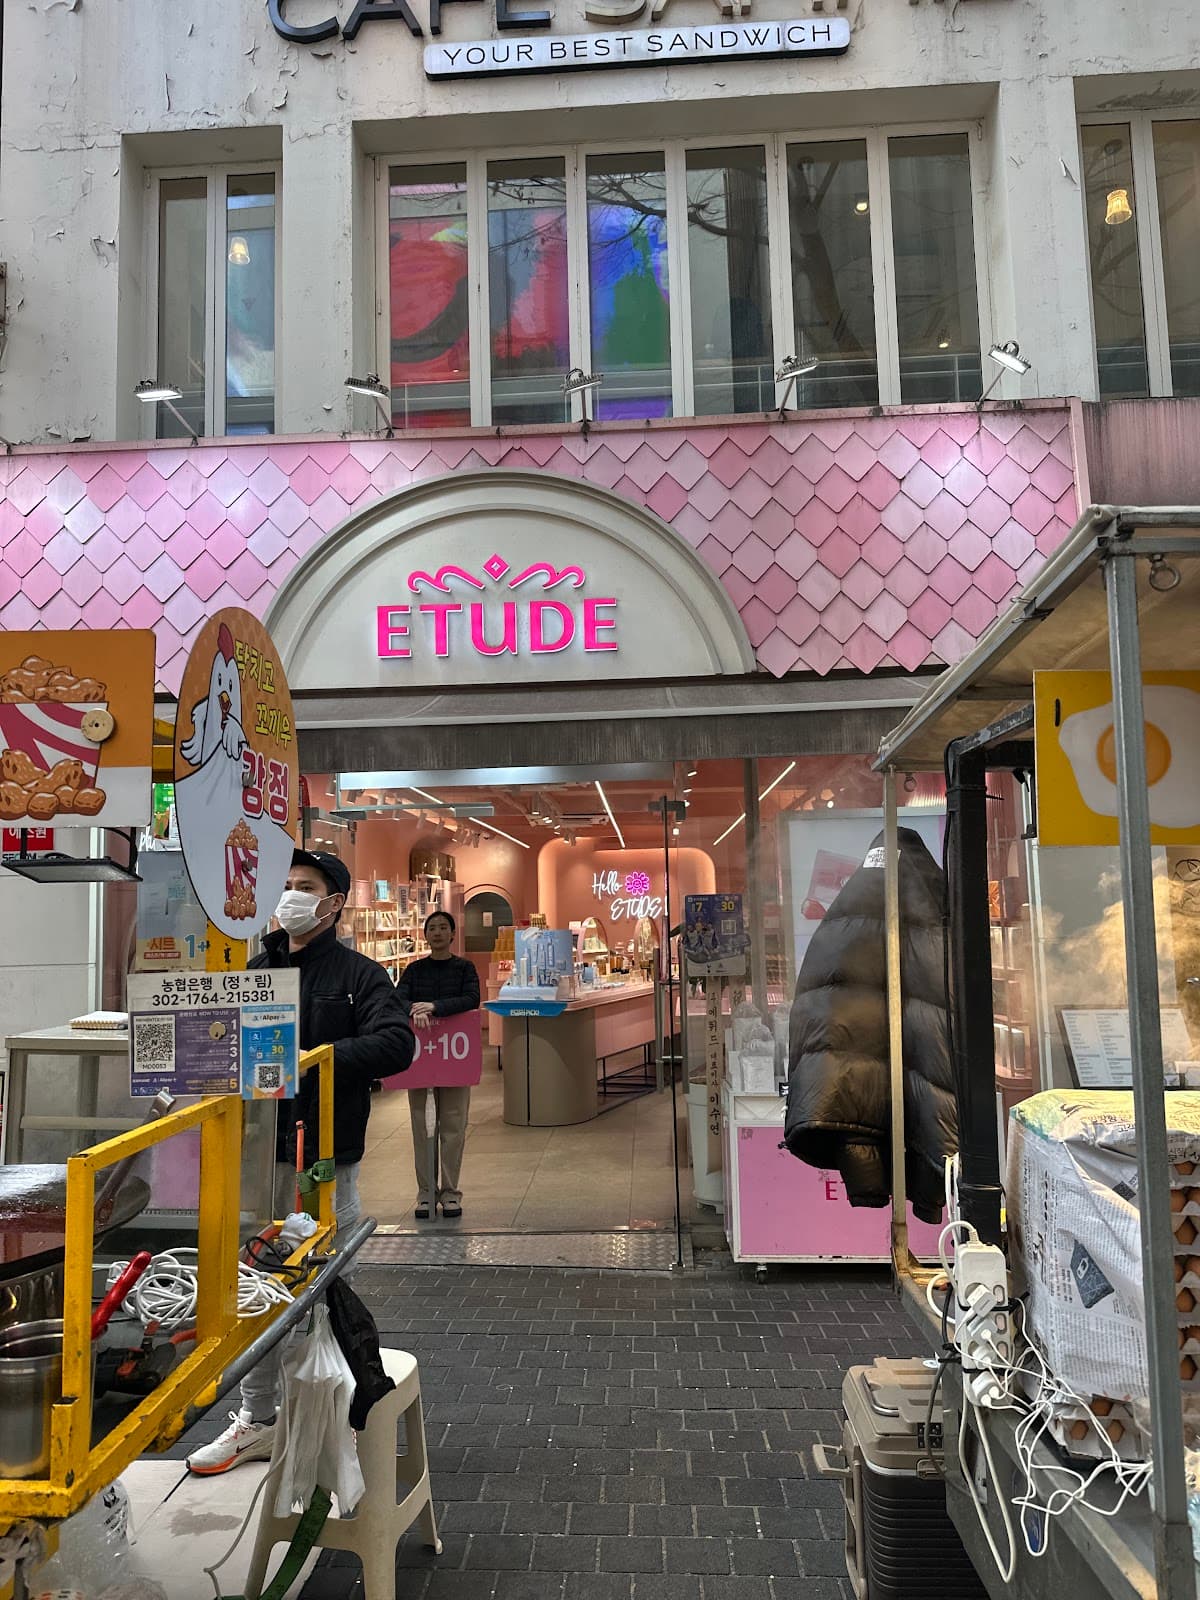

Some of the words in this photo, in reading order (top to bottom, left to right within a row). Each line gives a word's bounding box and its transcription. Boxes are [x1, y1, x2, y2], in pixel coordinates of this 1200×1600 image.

[443, 44, 534, 66] YOUR
[549, 37, 634, 60] BEST
[646, 24, 832, 54] SANDWICH
[377, 597, 619, 660] ETUDE
[234, 640, 276, 695] 닥치고
[241, 750, 290, 825] 강정
[2, 853, 37, 862] SECM
[592, 870, 623, 900] Hello
[721, 901, 735, 911] 30
[161, 976, 213, 992] 농협은행
[152, 990, 275, 1007] 302-1764-215381
[231, 1018, 237, 1030] 1
[230, 1034, 238, 1045] 2
[274, 1029, 281, 1040] 7
[230, 1047, 238, 1057] 3
[271, 1045, 284, 1055] 30
[229, 1062, 238, 1072] 4
[229, 1078, 238, 1089] 5
[709, 1093, 721, 1136] 이수연
